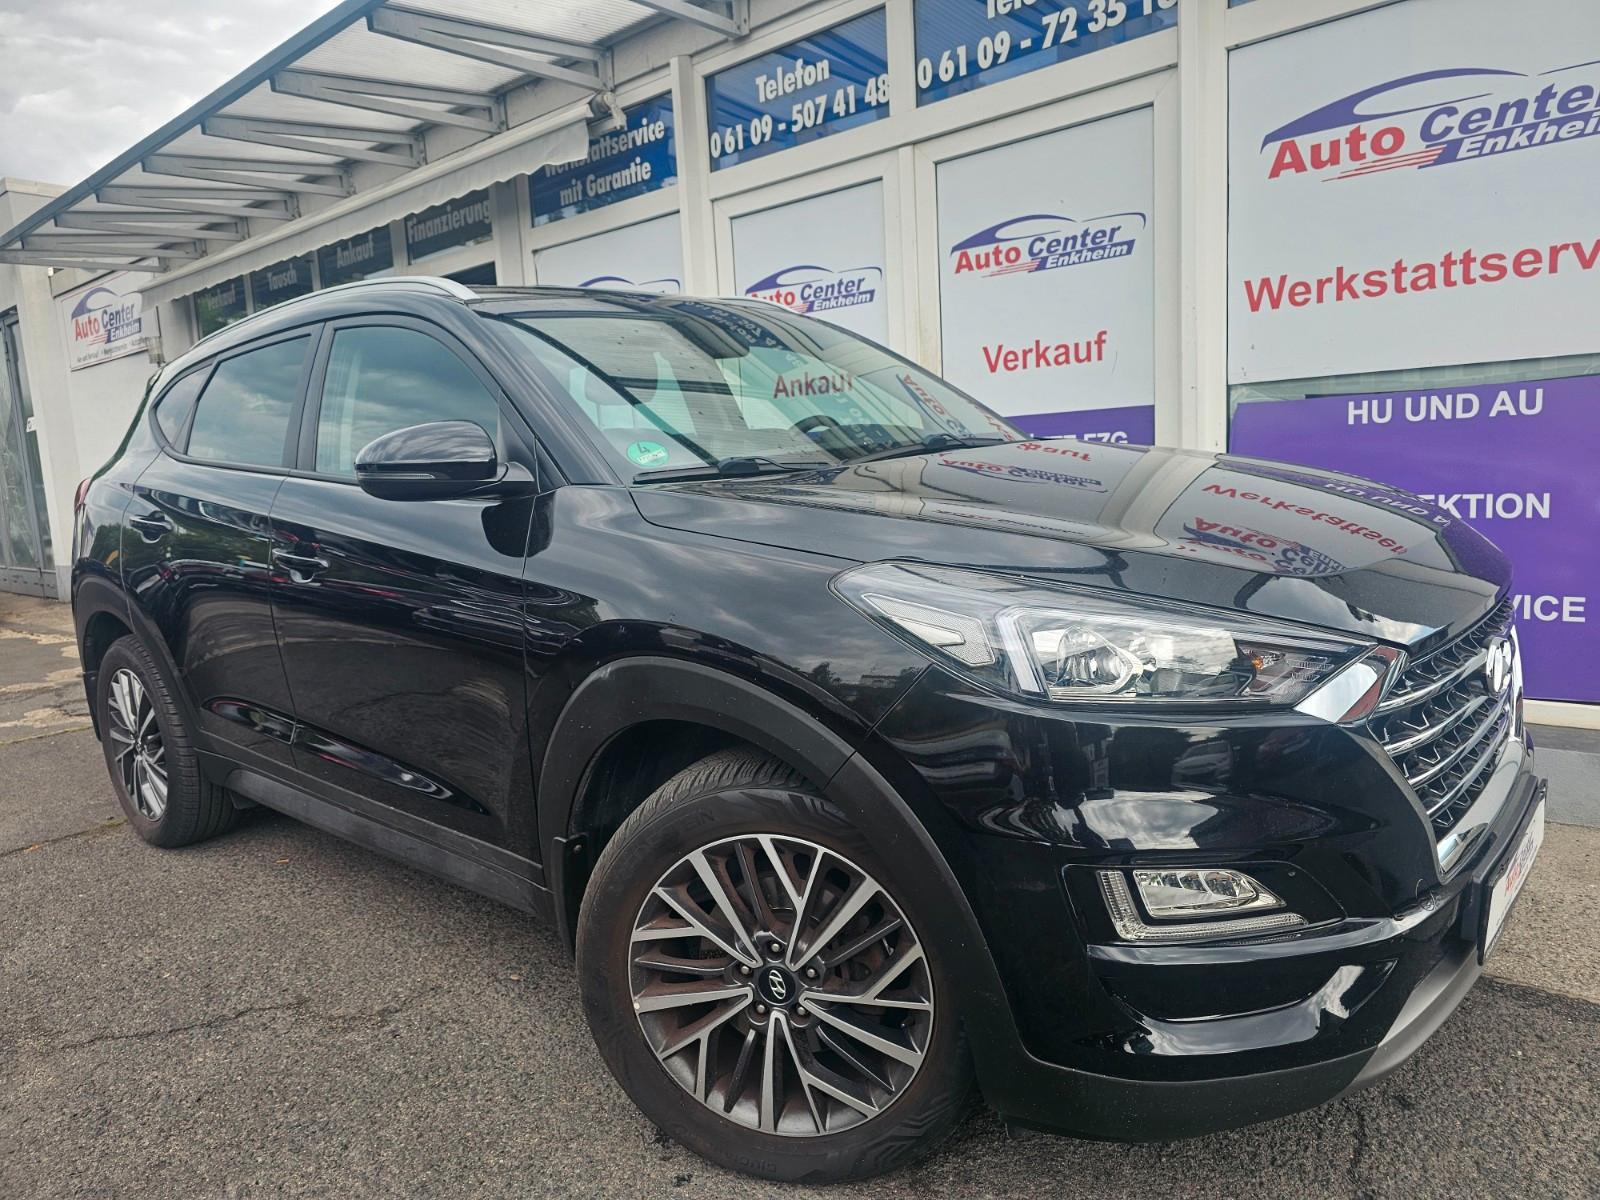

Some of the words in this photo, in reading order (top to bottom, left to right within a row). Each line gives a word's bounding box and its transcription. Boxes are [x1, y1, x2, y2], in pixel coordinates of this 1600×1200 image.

[917, 57, 933, 89] 0
[938, 45, 968, 82] 61
[977, 30, 1011, 70] 09
[1042, 6, 1078, 49] 72
[1087, 0, 1127, 33] 35
[755, 58, 830, 103] Telefon
[710, 132, 721, 158] 0
[724, 123, 744, 154] 61
[750, 114, 773, 147] 09
[791, 94, 828, 133] 507
[833, 84, 856, 117] 41
[864, 73, 891, 107] 48
[1268, 124, 1406, 179] Auto
[1419, 82, 1600, 143] Cente
[1456, 110, 1600, 160] Enkhei
[560, 178, 583, 206] mit
[586, 157, 652, 197] Garantie
[406, 200, 493, 244] Finanzierung
[336, 234, 375, 269] Ankauf
[954, 244, 1021, 275] Auto
[1028, 225, 1121, 258] Center
[1046, 244, 1128, 269] Enkheim
[266, 263, 298, 292] Tausch
[800, 276, 866, 301] Center
[1244, 238, 1600, 312] Werkstattserv
[75, 315, 101, 342] Auto
[101, 304, 135, 329] Center
[813, 293, 871, 312] Enkheim
[983, 331, 1107, 374] Verkauf
[1347, 398, 1393, 425] HU
[1405, 393, 1480, 422] UND
[1489, 388, 1544, 417] AU
